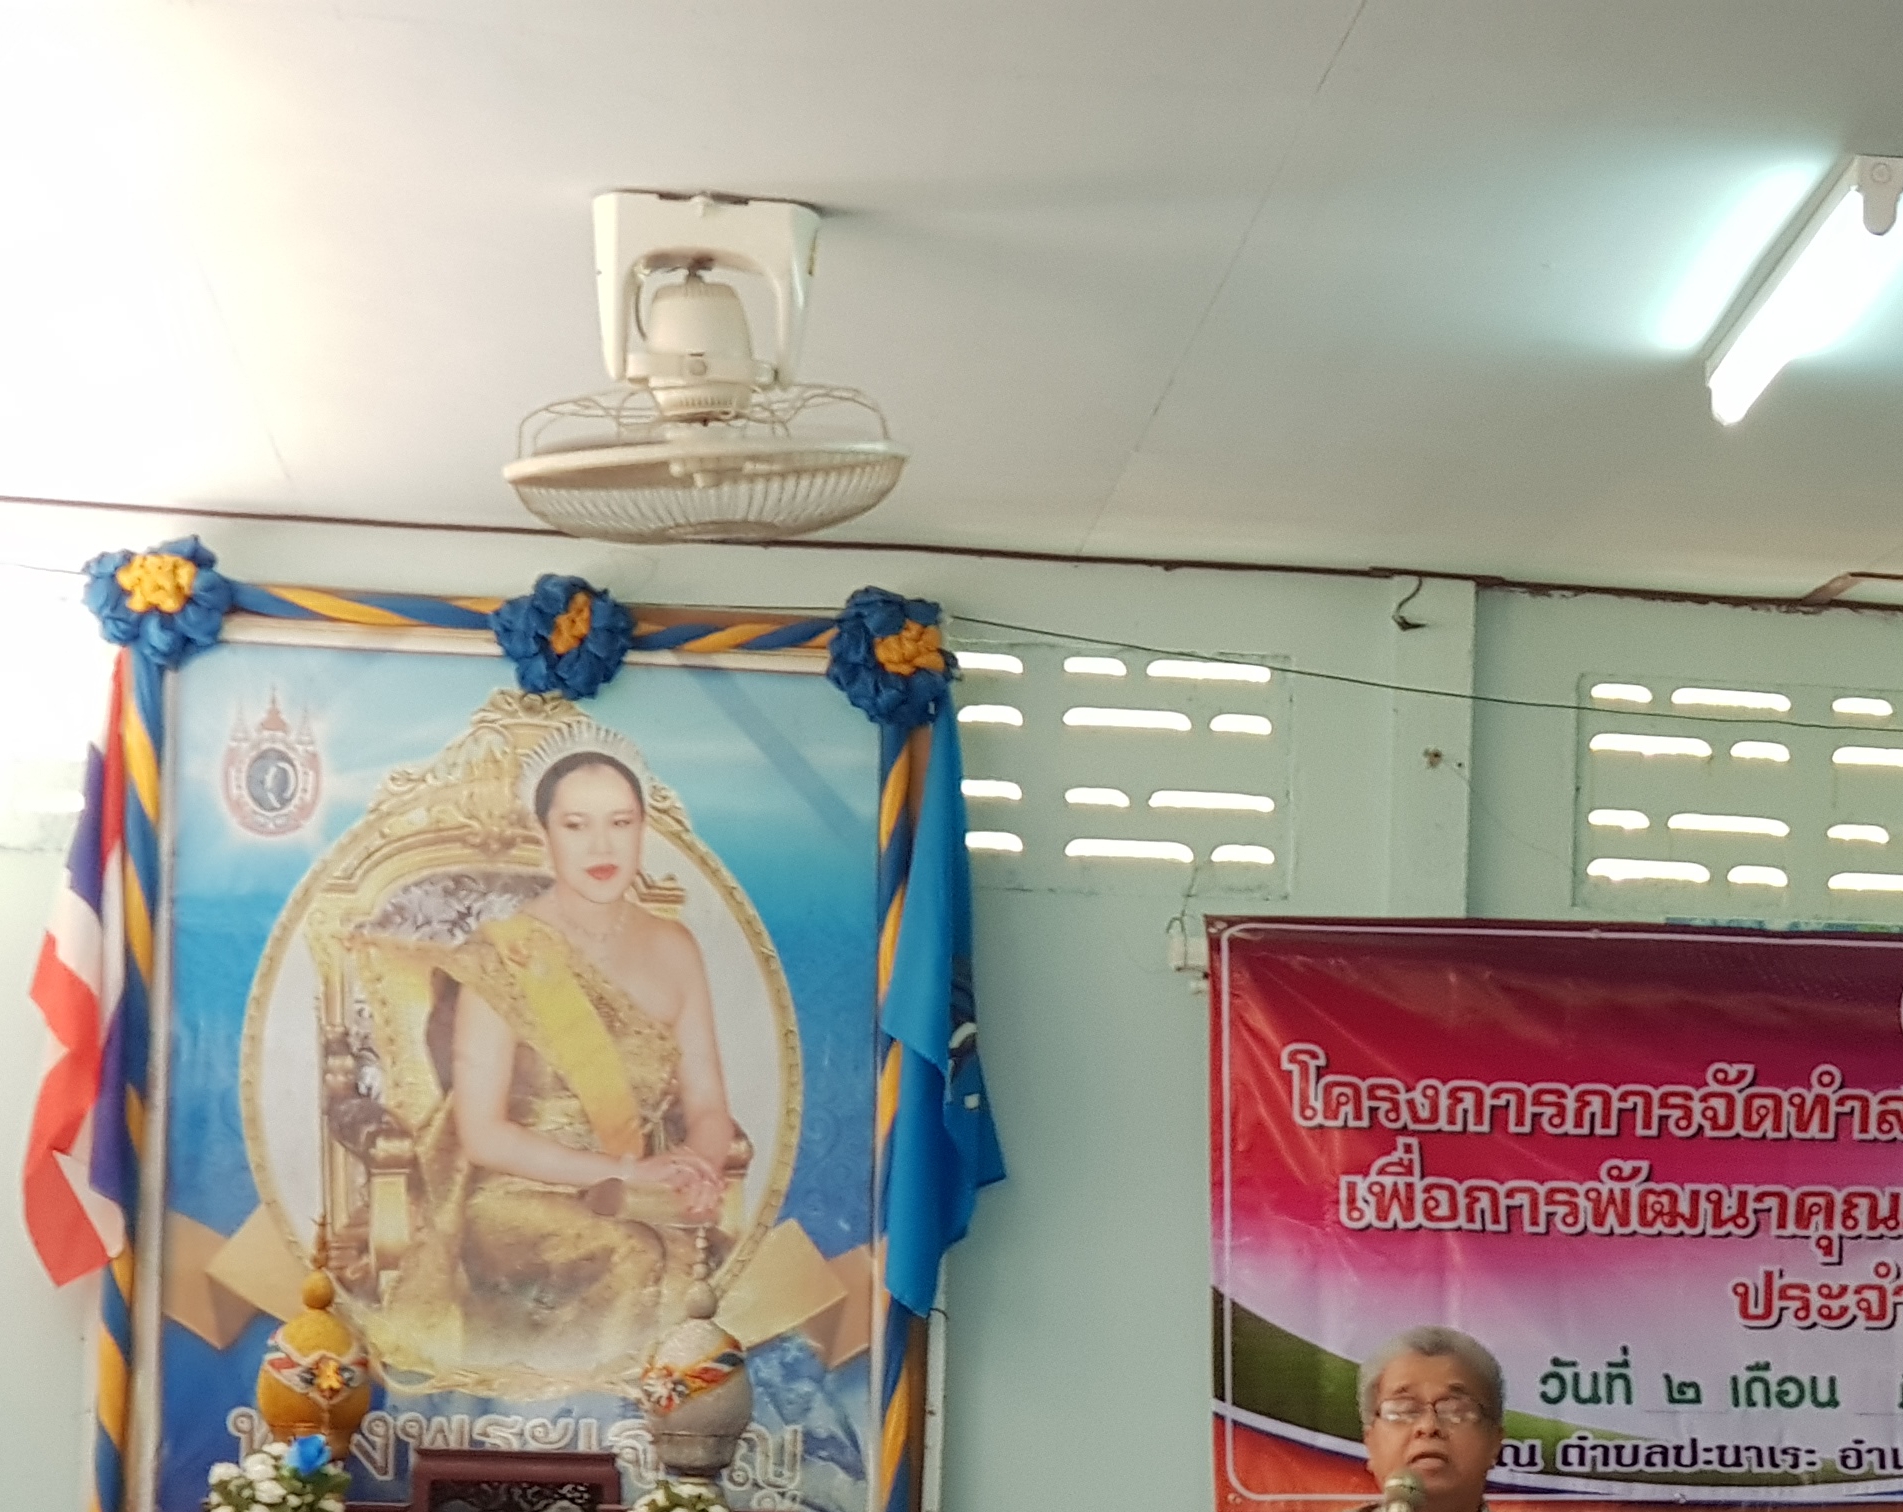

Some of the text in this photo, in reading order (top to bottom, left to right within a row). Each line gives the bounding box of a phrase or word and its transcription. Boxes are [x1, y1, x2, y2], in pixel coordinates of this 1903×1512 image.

[1538, 1345, 1634, 1406] วันที่
[1663, 1372, 1703, 1405] ๒
[1729, 1360, 1841, 1409] เดือน
[1560, 1434, 1817, 1470] ตำบลปะนาเระ
